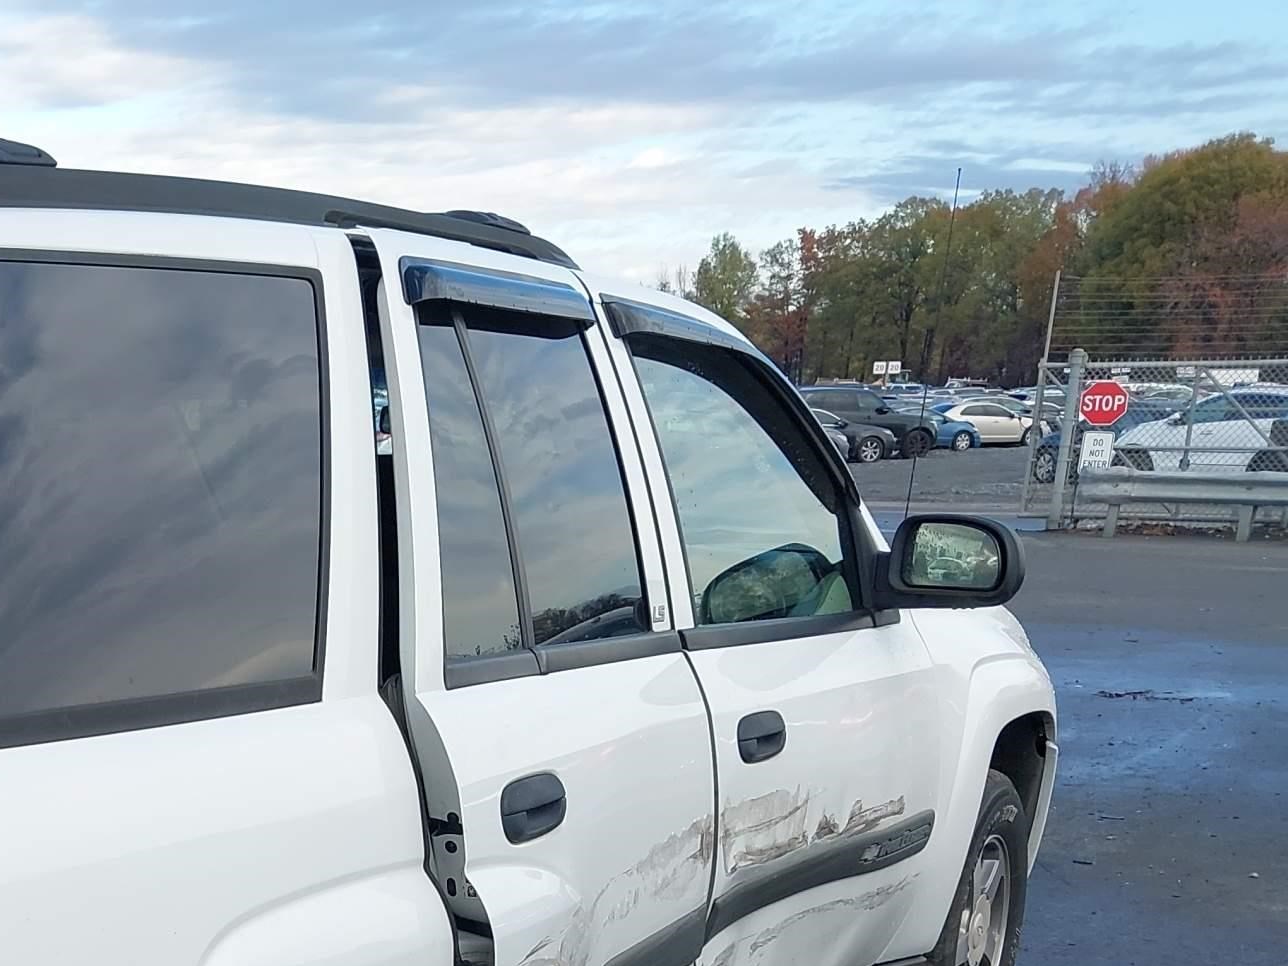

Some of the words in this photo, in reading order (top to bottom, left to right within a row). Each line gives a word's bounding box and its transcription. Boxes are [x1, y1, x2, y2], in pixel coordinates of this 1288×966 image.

[1082, 394, 1125, 412] STOP
[1093, 438, 1104, 447] DO
[1089, 450, 1104, 458] NOT
[1082, 459, 1108, 468] ENTER
